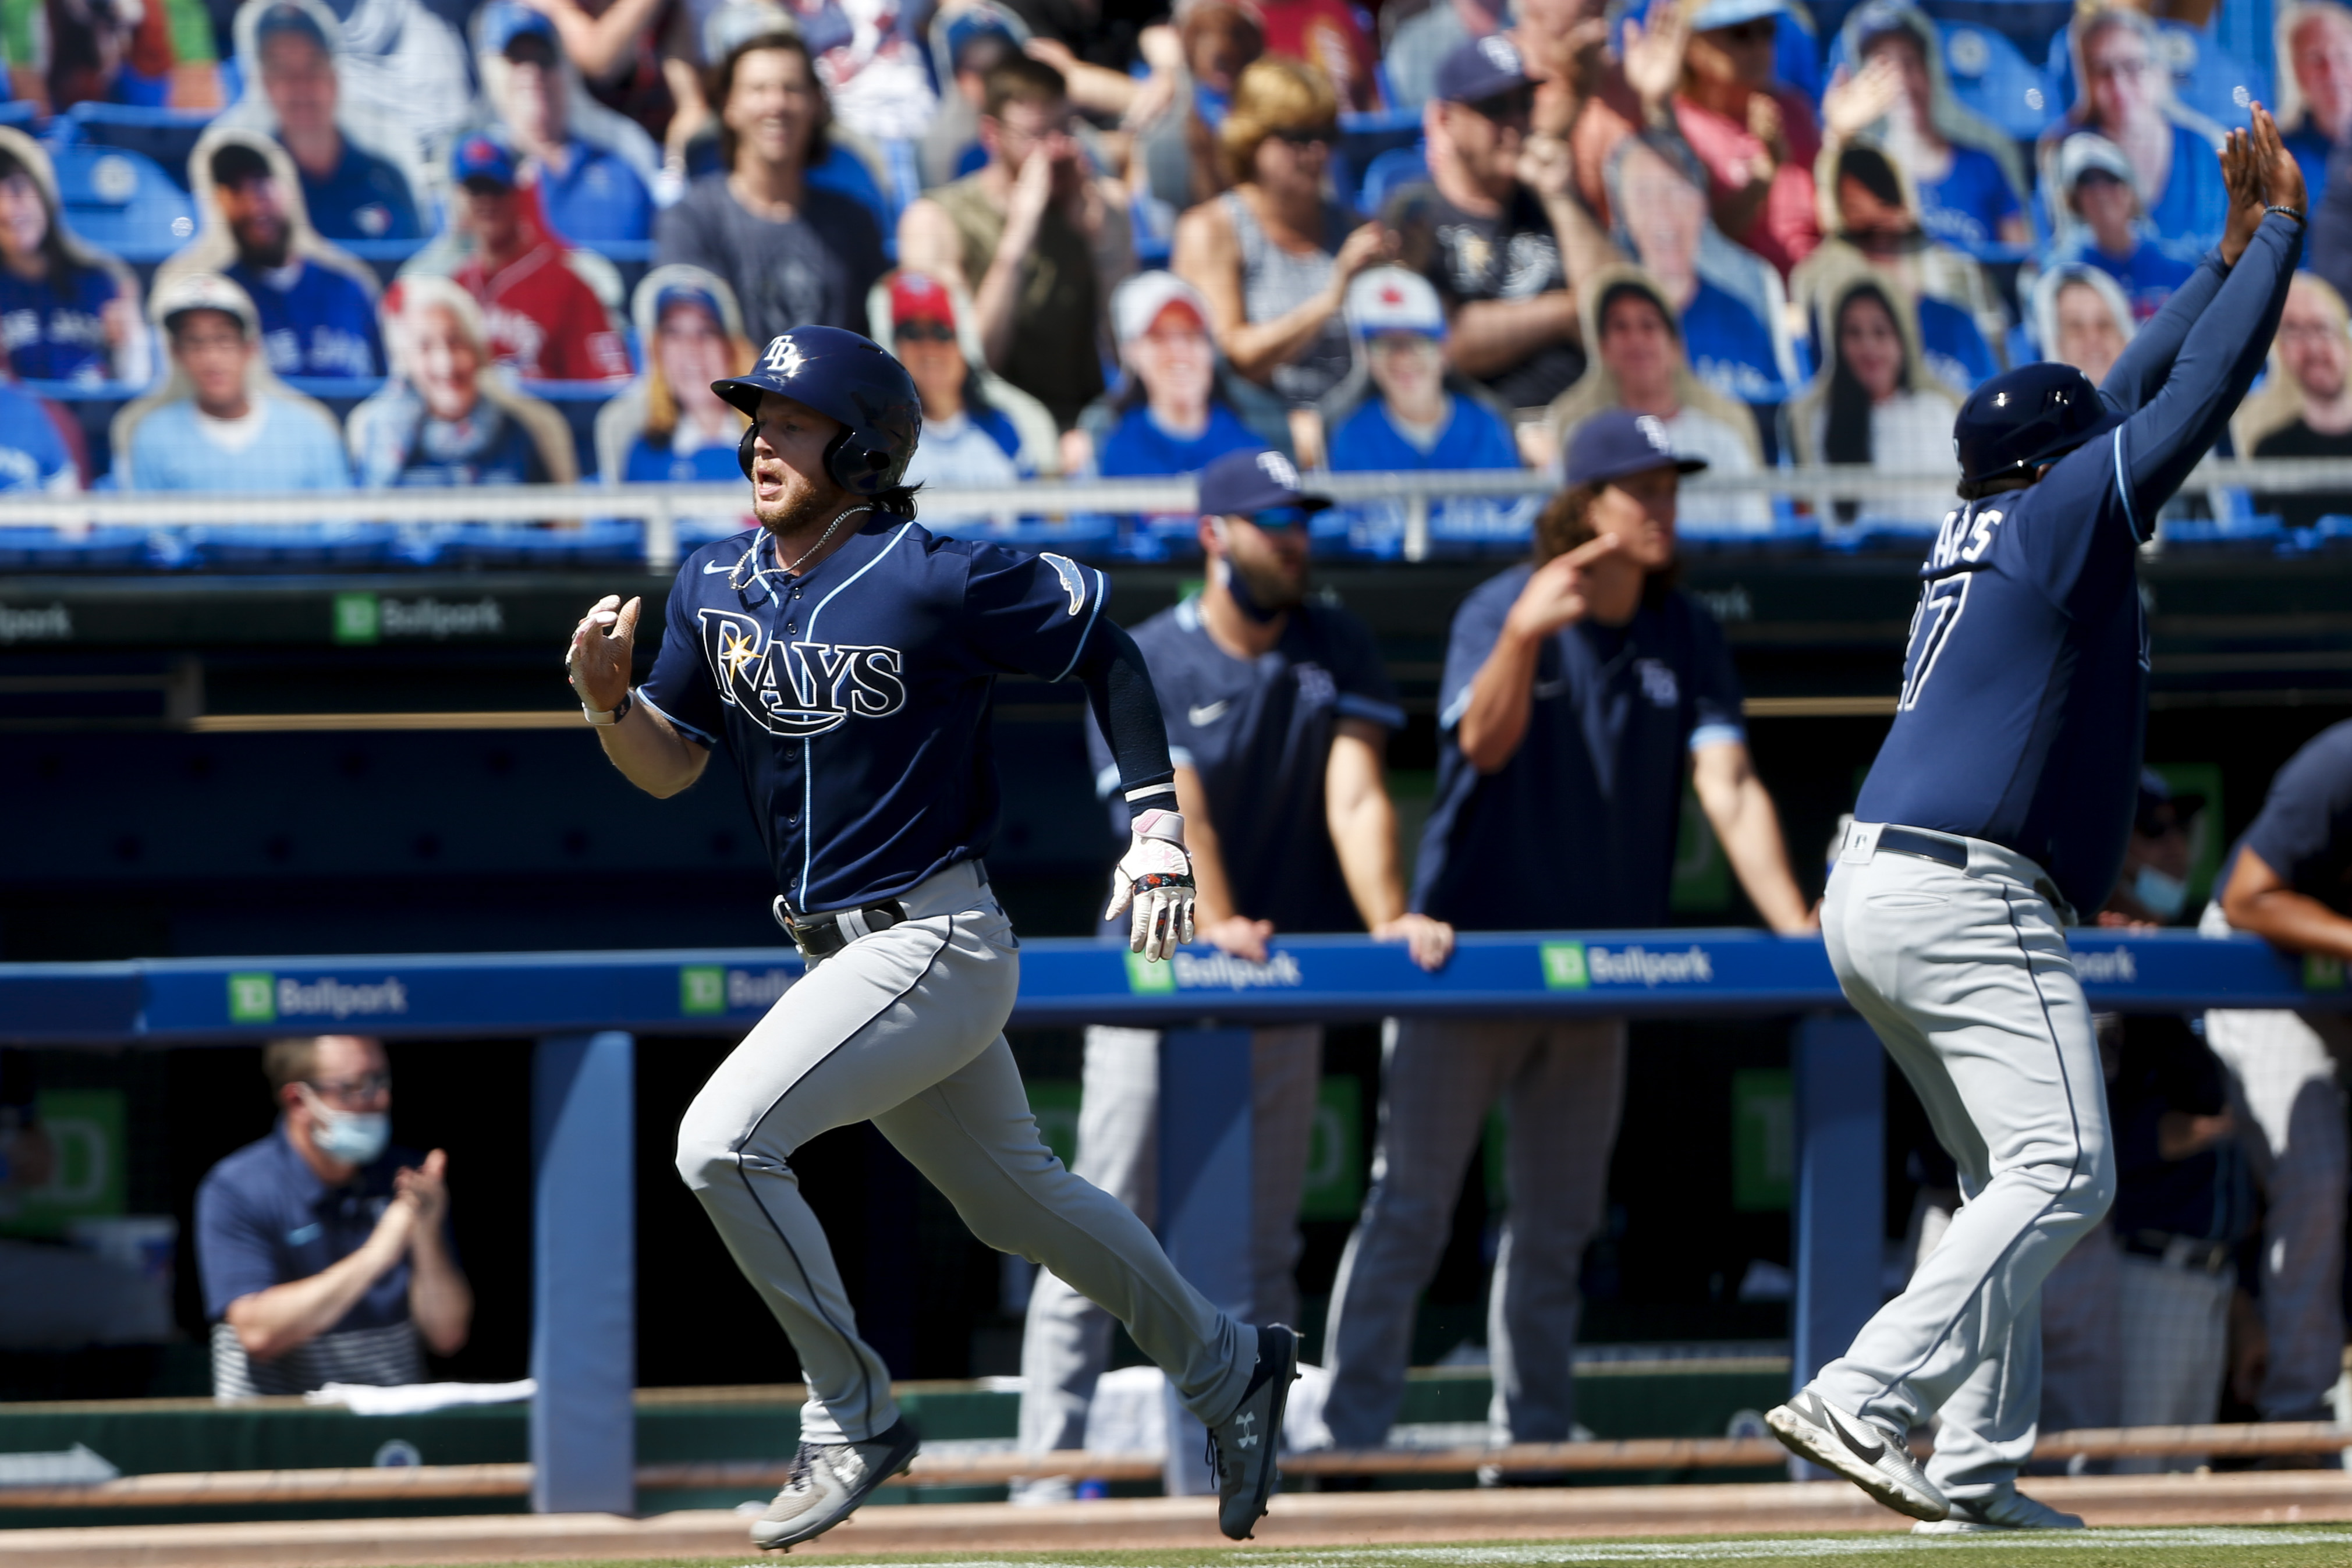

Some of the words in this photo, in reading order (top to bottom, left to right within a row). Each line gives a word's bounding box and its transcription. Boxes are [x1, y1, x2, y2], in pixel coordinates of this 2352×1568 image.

[764, 335, 797, 371] TB
[698, 608, 905, 737] RAYS
[1173, 951, 1303, 991] Ballpark
[1545, 946, 1585, 984] TD
[1588, 945, 1714, 988] Ballpark
[234, 979, 272, 1016] TD
[279, 977, 407, 1020] Ballpark
[686, 971, 722, 1007] TD
